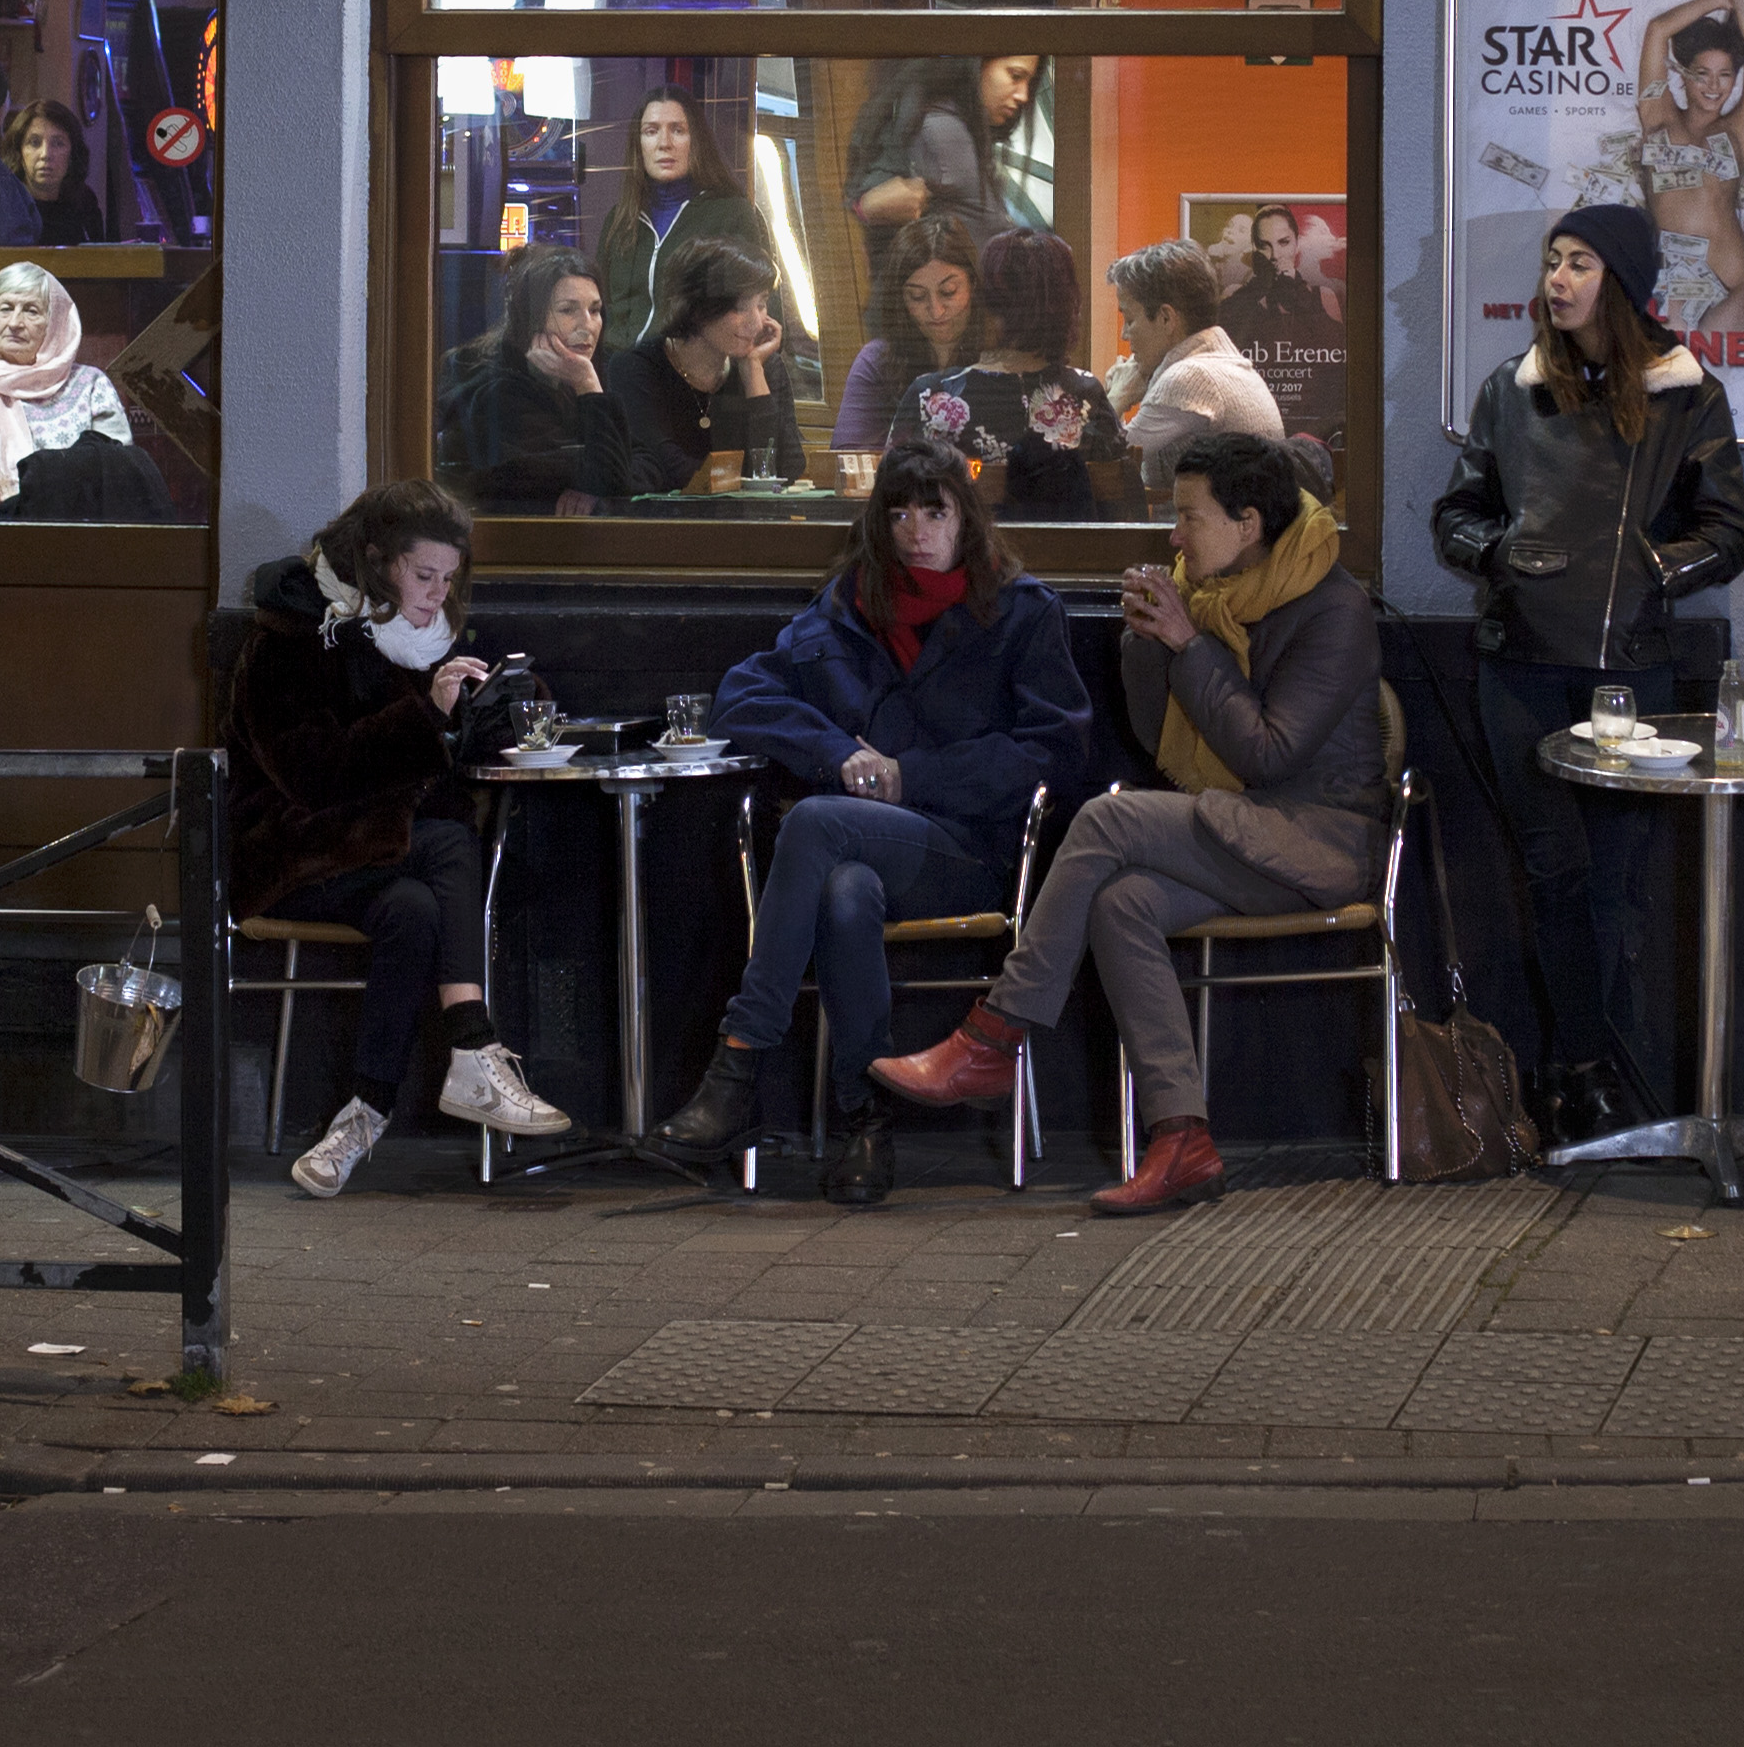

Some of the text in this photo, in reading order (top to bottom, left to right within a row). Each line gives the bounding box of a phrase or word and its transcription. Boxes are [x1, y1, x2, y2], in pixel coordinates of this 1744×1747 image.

[1481, 24, 1602, 67] STAR
[1509, 106, 1606, 116] GAMES SPORTS
[1267, 366, 1312, 379] concert
[1282, 383, 1303, 392] 2017
